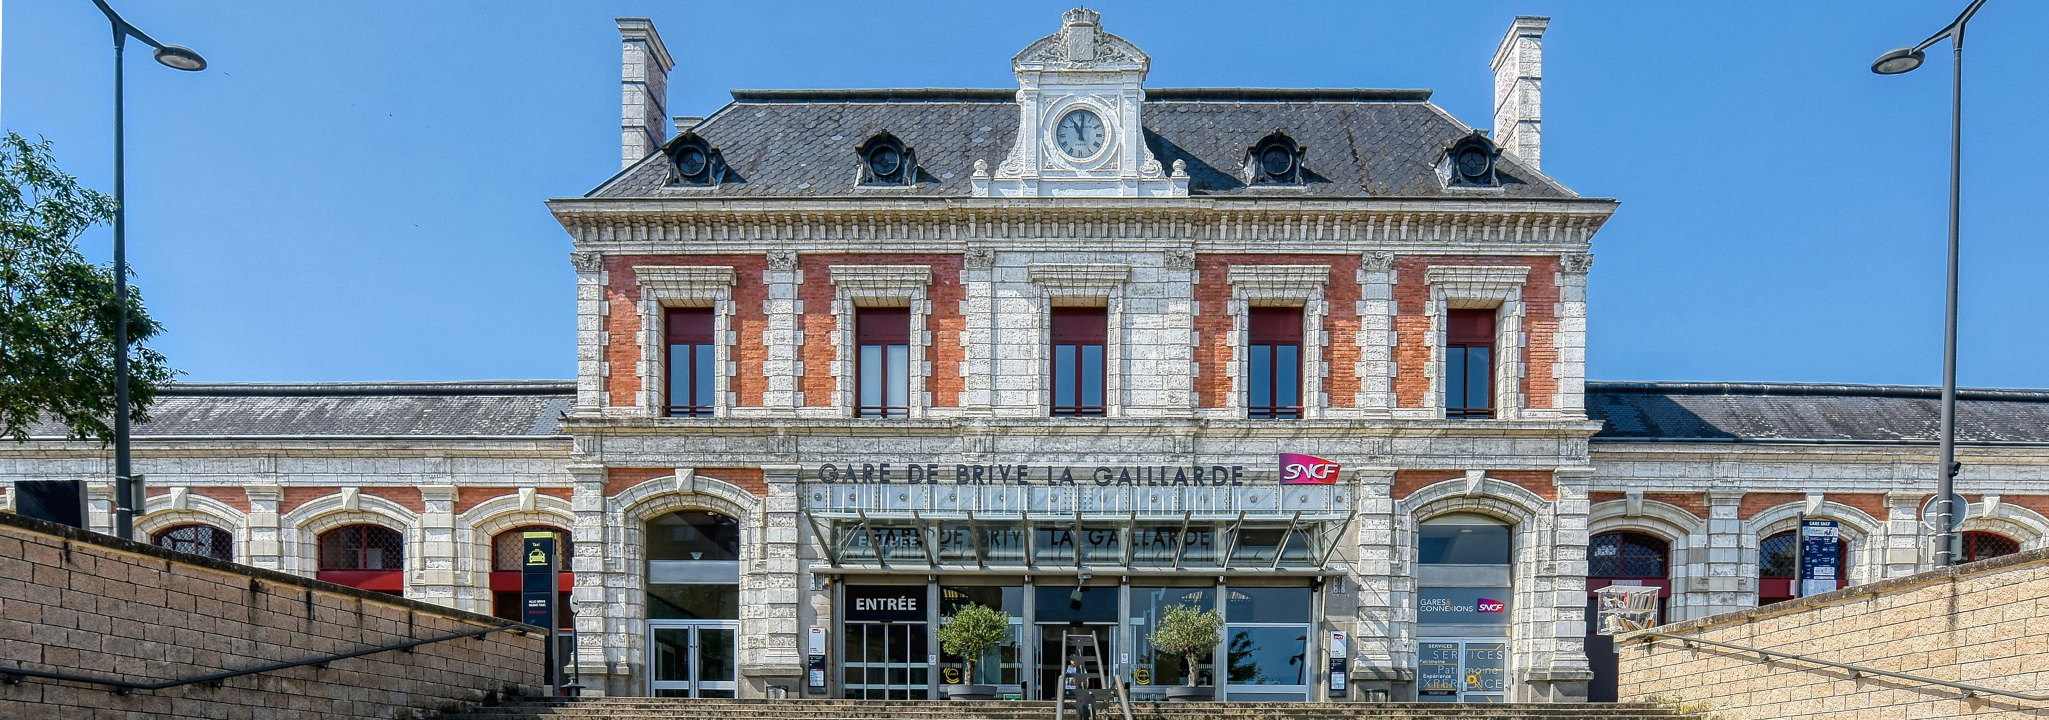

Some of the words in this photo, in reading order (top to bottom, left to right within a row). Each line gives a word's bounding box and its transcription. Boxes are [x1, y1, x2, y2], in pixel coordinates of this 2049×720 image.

[818, 463, 891, 485] GARE
[908, 463, 939, 485] DE
[956, 464, 1029, 486] BRIVE
[1047, 466, 1075, 487] LA
[1093, 465, 1243, 487] GAILLARDE
[1283, 463, 1339, 481] SNCF
[856, 595, 916, 610] ENTRÉE
